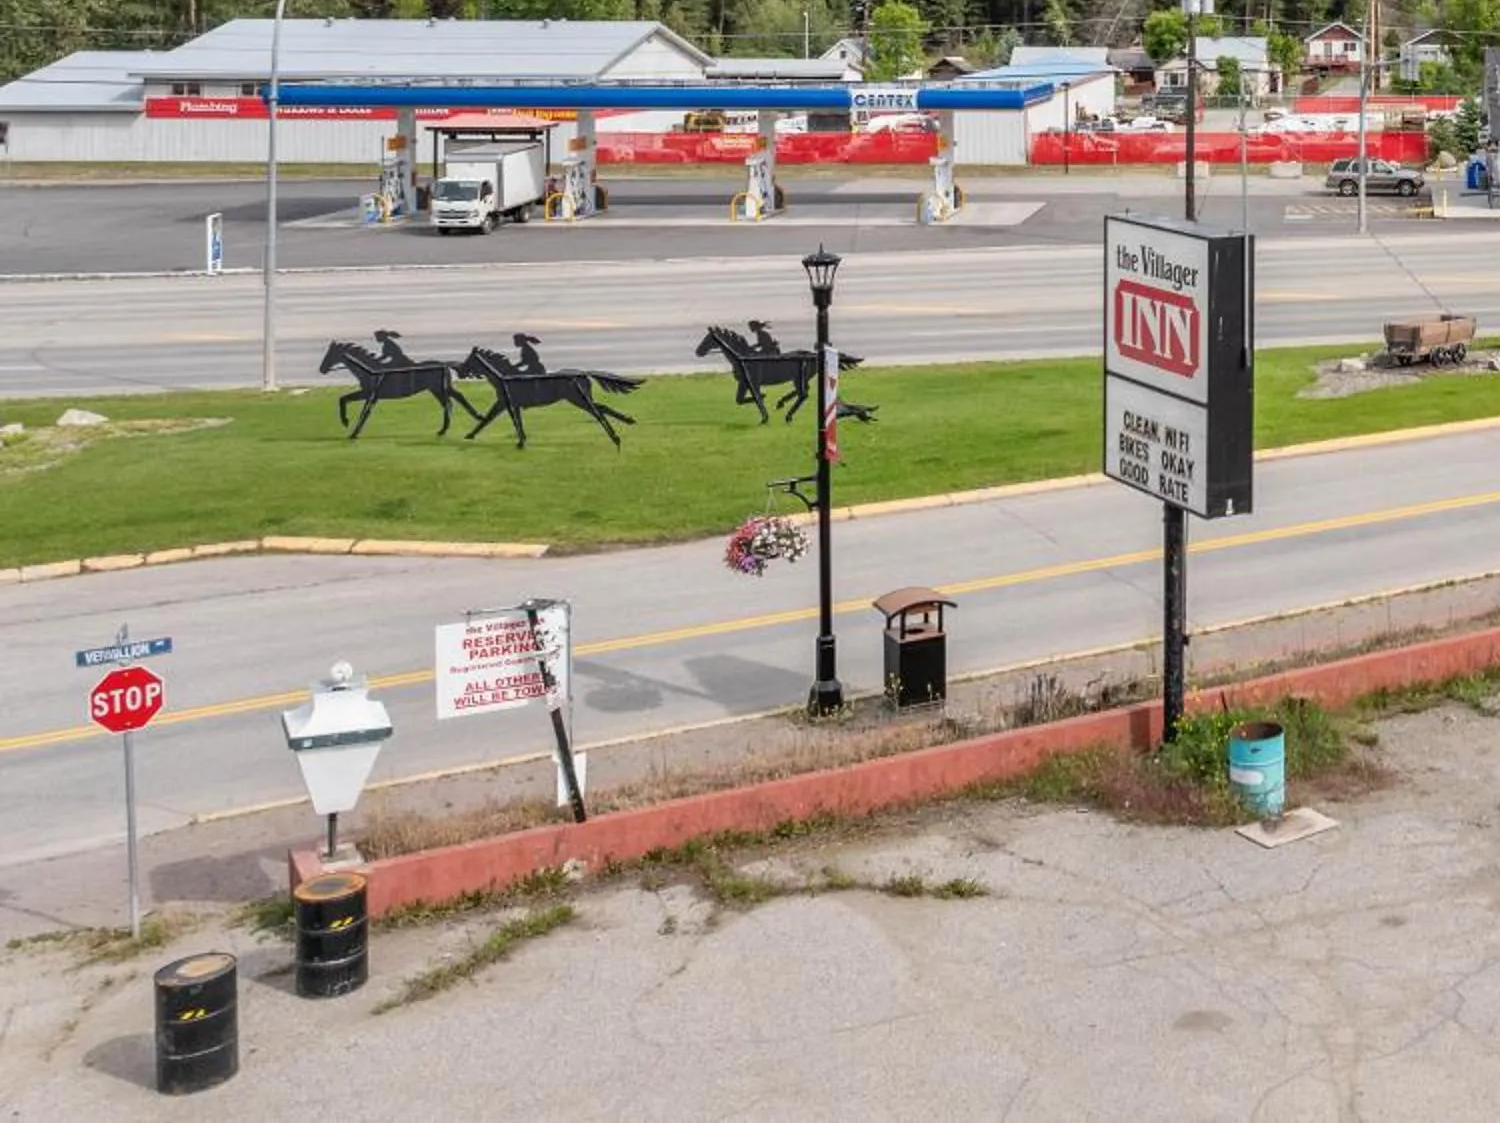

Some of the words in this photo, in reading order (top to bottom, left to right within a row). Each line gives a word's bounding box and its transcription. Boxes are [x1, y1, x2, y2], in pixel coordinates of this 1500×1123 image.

[1116, 244, 1138, 272] the
[1140, 244, 1199, 291] Villager
[1119, 290, 1193, 367] INN
[1119, 432, 1149, 463] BIKES
[1161, 450, 1195, 479] OKAY
[1119, 458, 1149, 486] GOOD
[1159, 474, 1189, 503] RATE
[93, 682, 161, 718] STOP
[453, 693, 485, 707] WILL
[465, 680, 491, 692] ALL
